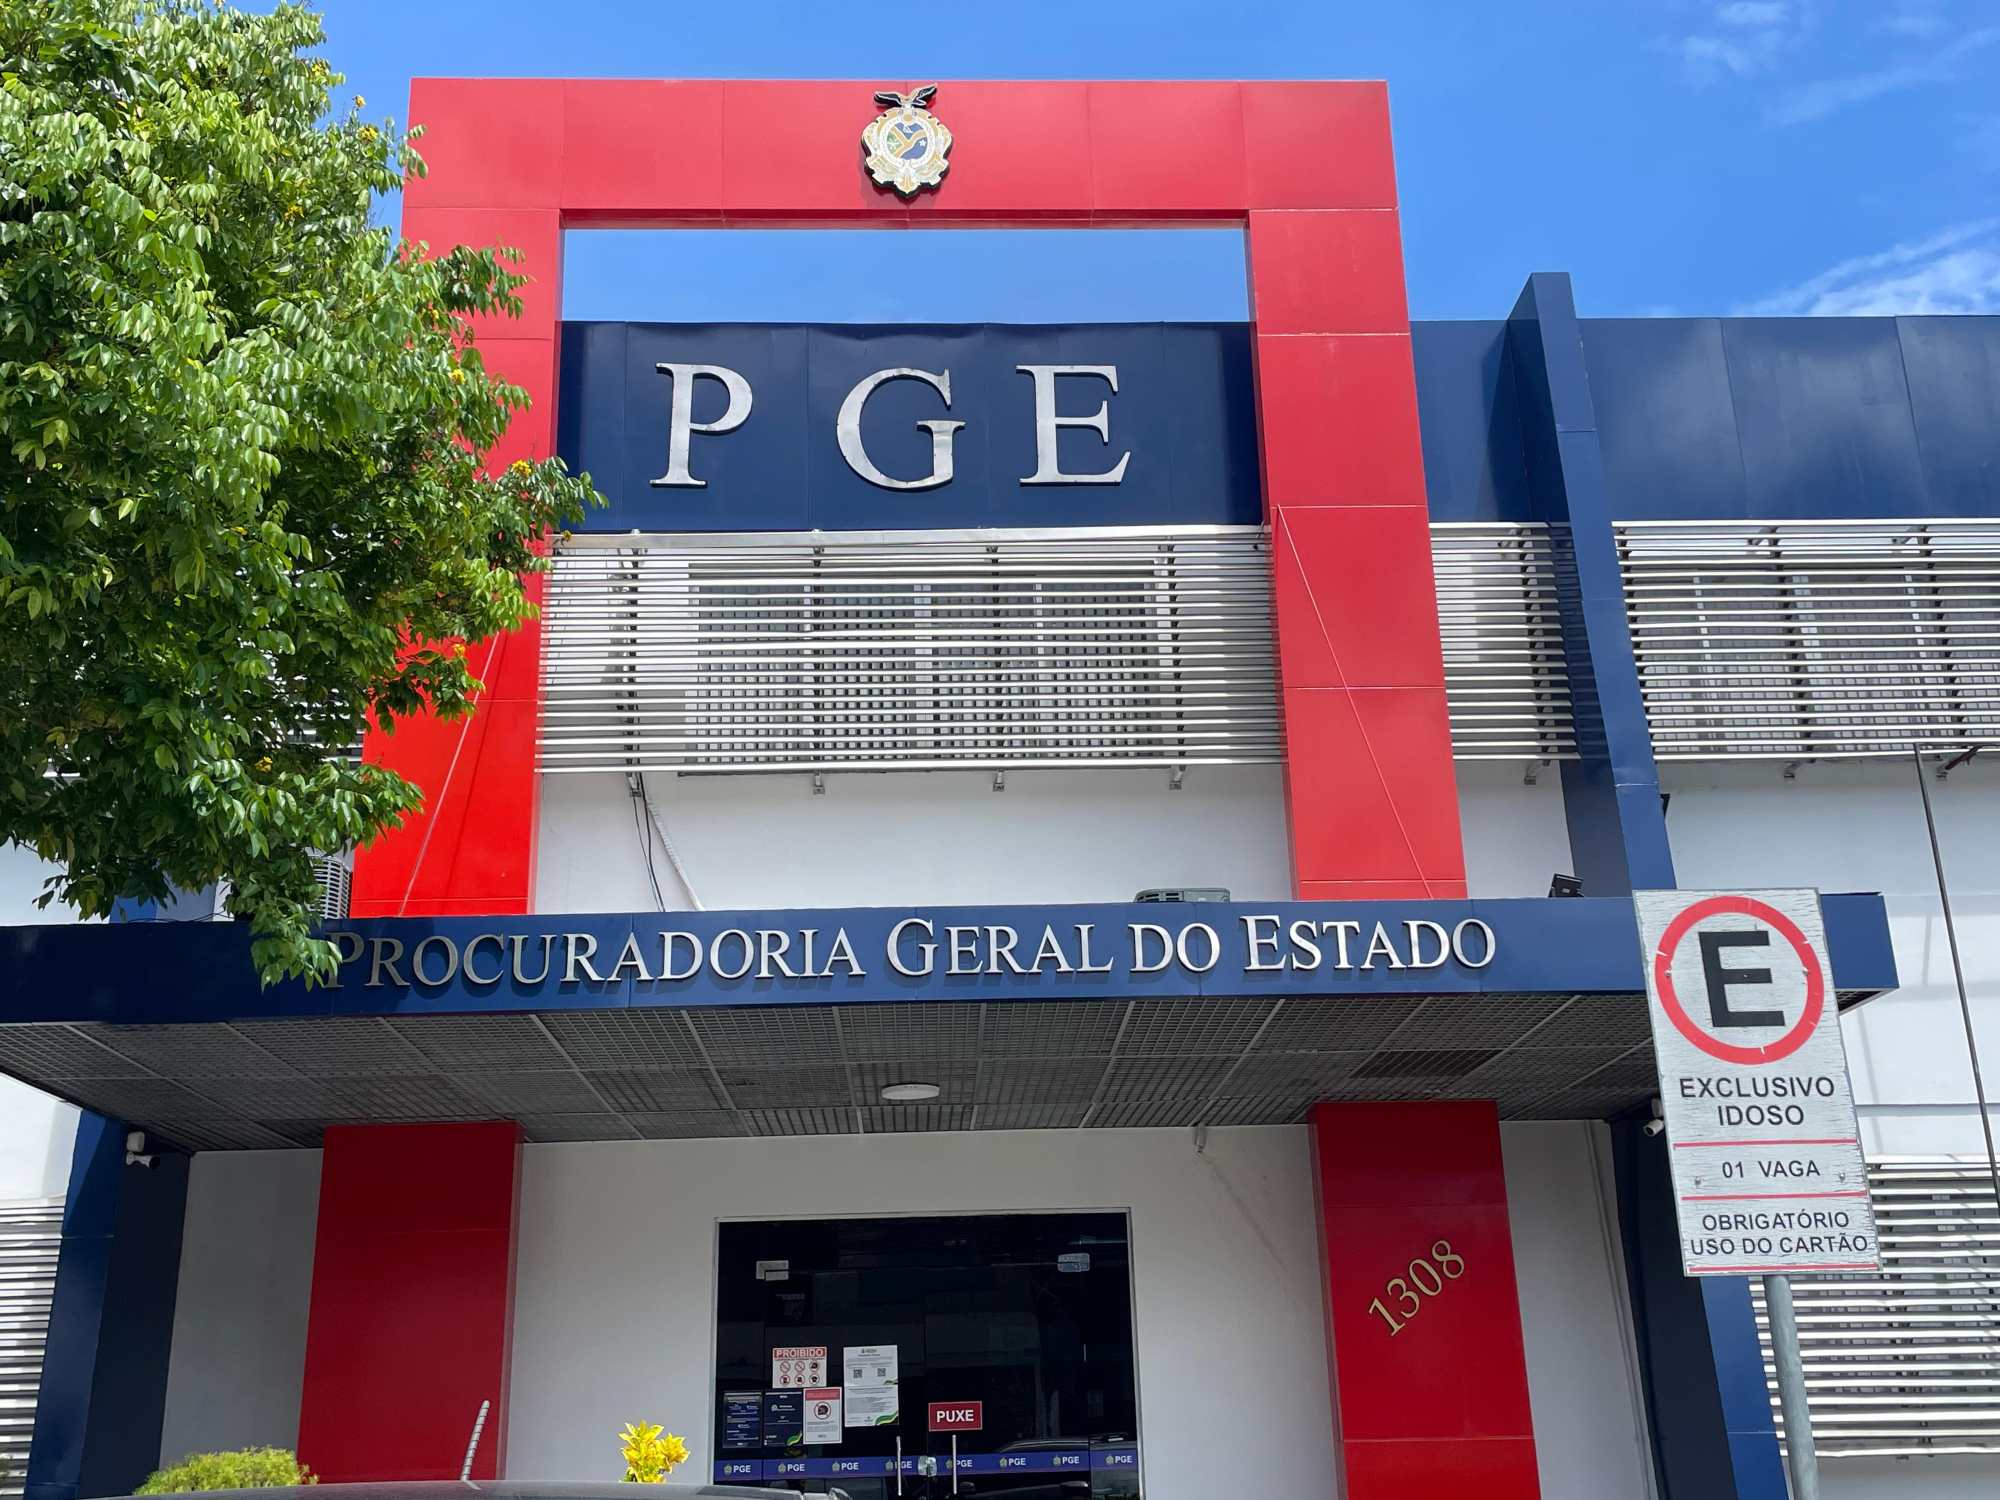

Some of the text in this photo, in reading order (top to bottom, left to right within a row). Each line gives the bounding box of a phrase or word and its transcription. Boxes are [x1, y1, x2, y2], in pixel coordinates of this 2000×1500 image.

[323, 914, 1496, 989] PROCURADORIA GERAL DO ESTADO
[1698, 930, 1785, 1028] E
[1679, 1076, 1835, 1099] EXCLUSIVO
[1717, 1104, 1805, 1127] IDOSO
[1722, 1159, 1821, 1179] 01 VAGA
[1702, 1208, 1850, 1232] OBRIGATÓRIO
[1690, 1232, 1868, 1256] USO DO CARTÃO
[1368, 1239, 1465, 1337] 1308
[776, 1349, 824, 1359] PROIBIDO
[936, 1409, 975, 1423] PUXE
[787, 1463, 806, 1472] PGE
[841, 1462, 859, 1471] PGE
[1008, 1457, 1027, 1466] PGE
[1062, 1455, 1080, 1465] PGE
[1114, 1455, 1133, 1464] PGE
[733, 1464, 752, 1473] PGE
